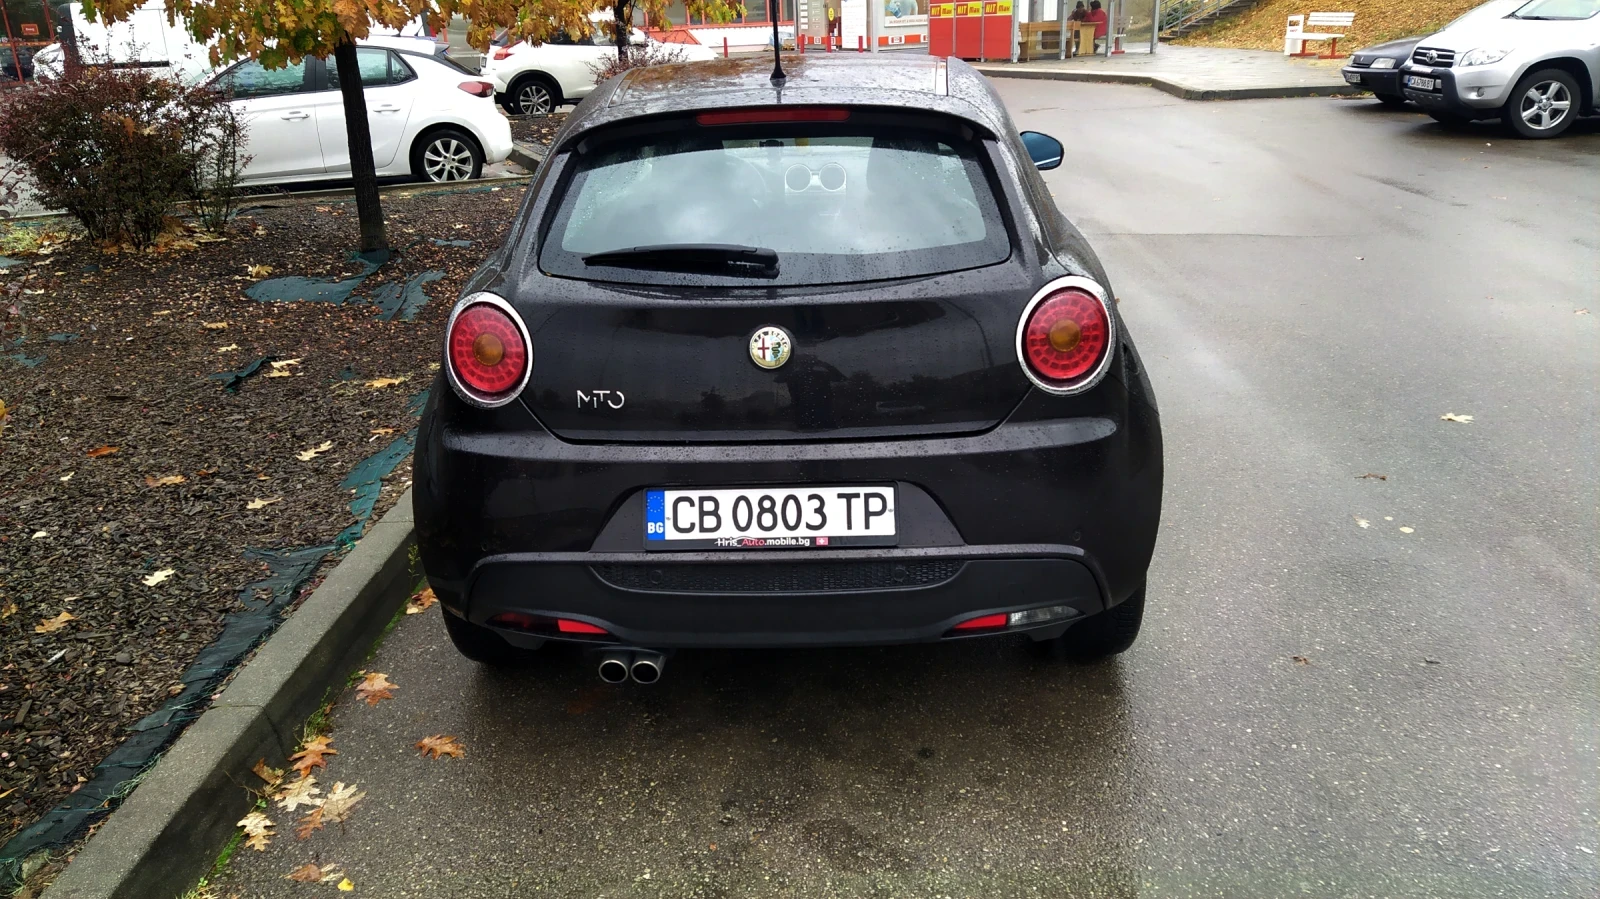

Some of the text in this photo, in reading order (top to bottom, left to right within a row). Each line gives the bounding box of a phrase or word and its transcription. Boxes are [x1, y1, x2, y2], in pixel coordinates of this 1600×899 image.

[672, 492, 888, 534] CB 0803 TP
[647, 522, 664, 534] BG
